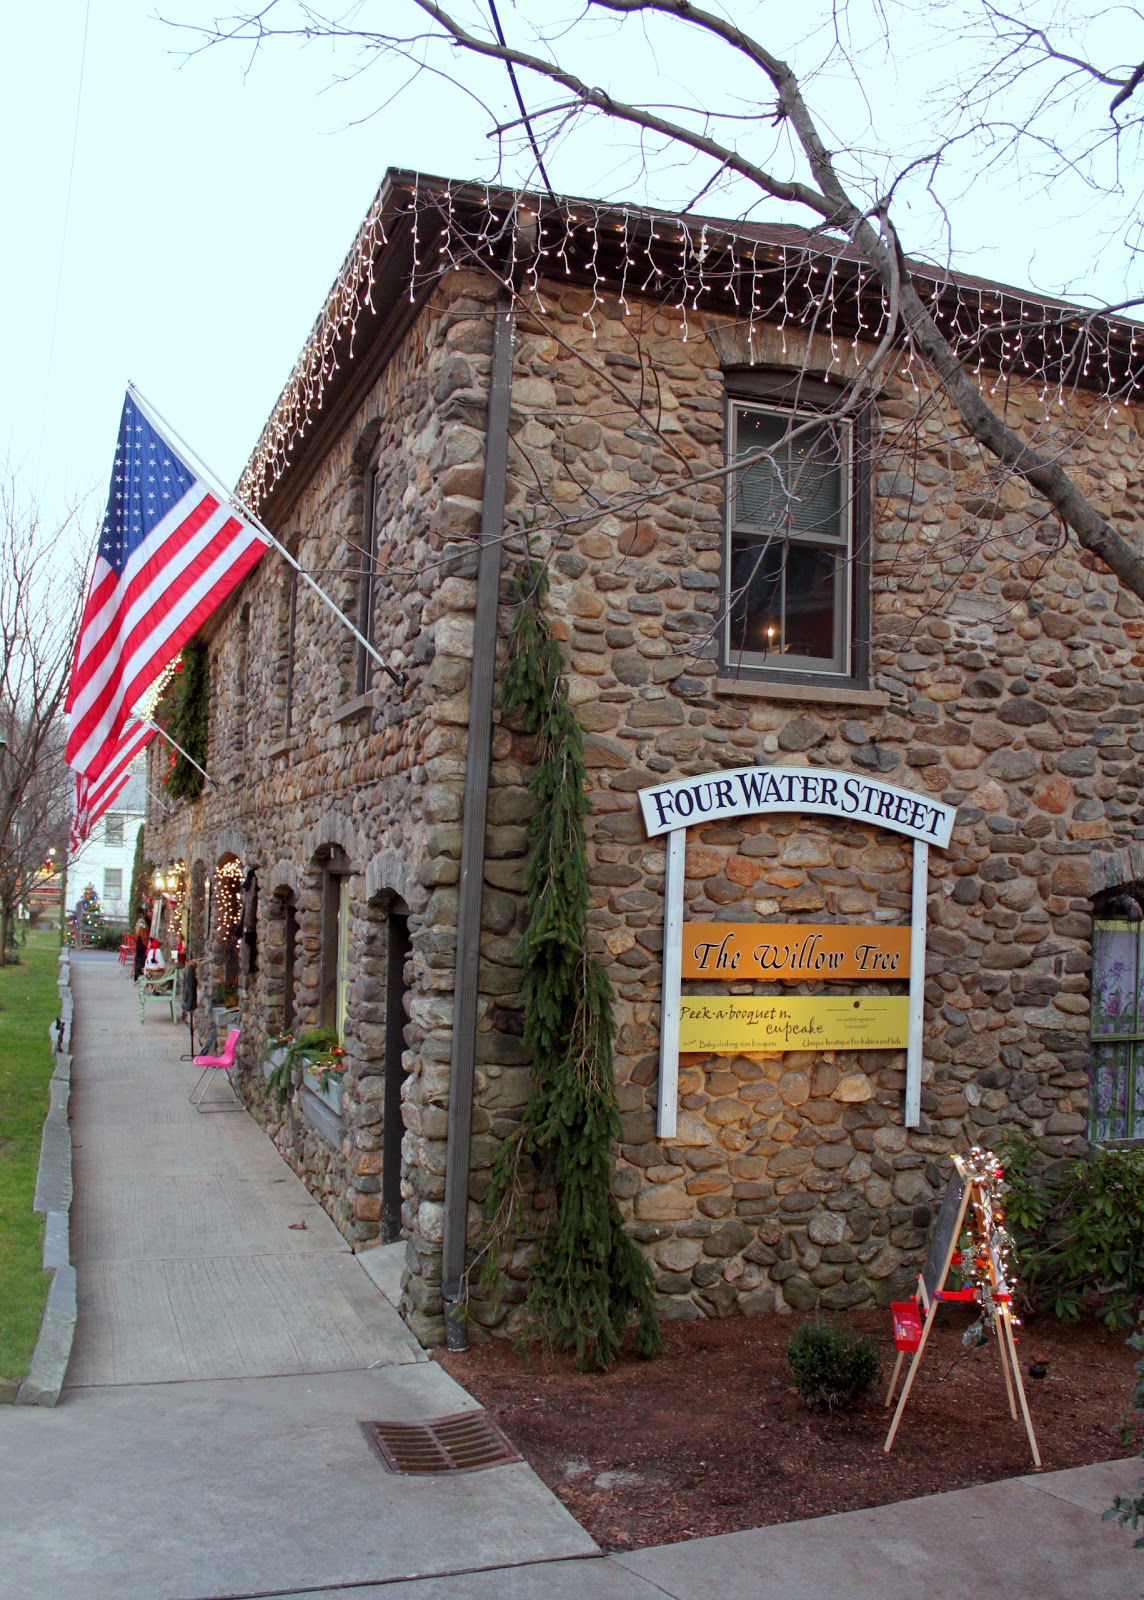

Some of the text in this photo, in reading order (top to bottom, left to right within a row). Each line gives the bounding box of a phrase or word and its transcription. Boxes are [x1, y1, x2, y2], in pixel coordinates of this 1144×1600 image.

[649, 772, 946, 836] FOUR WATER STREET
[694, 931, 900, 971] The Willow Tree
[766, 1017, 824, 1042] cupcake
[850, 1037, 860, 1045] for
[699, 1040, 716, 1050] Baby
